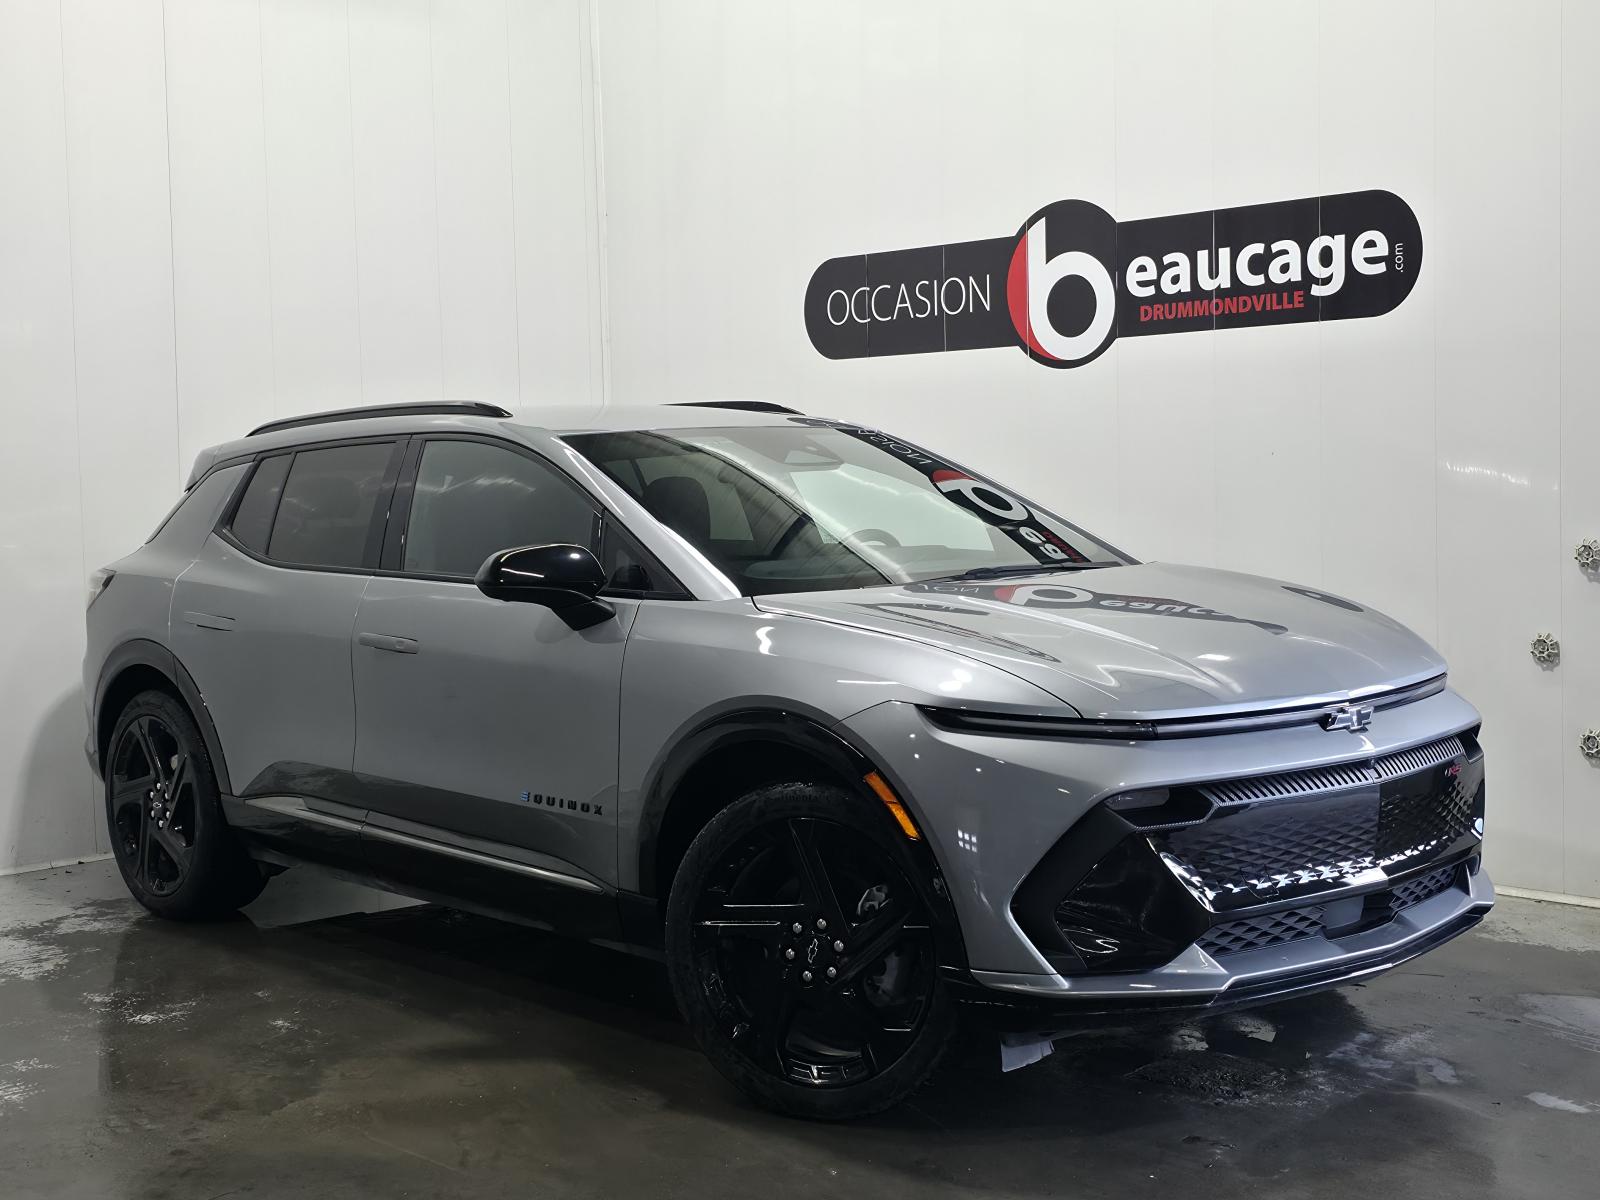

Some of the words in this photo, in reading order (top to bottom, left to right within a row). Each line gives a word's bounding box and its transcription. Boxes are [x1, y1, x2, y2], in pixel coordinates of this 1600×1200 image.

[827, 273, 991, 326] OCCASION
[1139, 290, 1304, 322] DRUMMONDVILLE
[520, 791, 603, 816] EQUINOX
